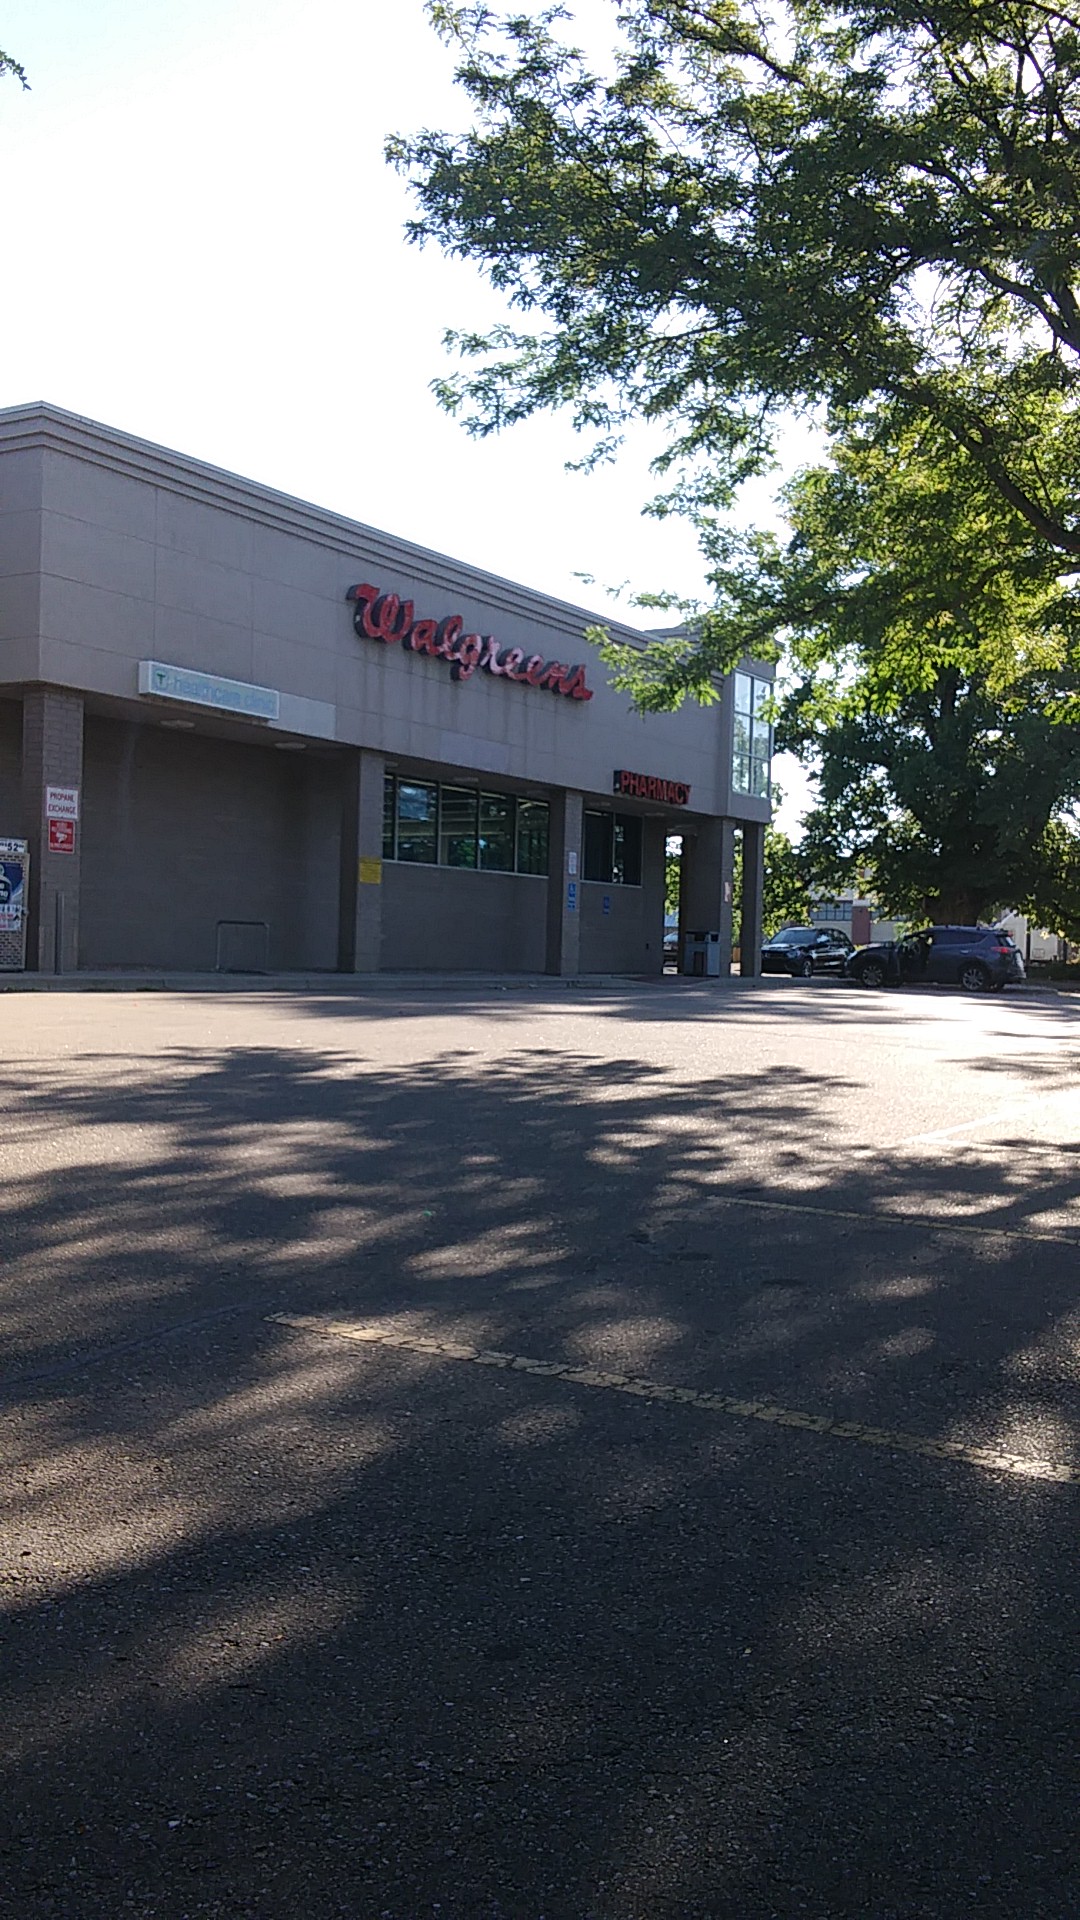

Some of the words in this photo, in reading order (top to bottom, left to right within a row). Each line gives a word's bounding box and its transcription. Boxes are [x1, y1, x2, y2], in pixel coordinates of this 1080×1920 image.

[349, 583, 593, 700] Walgreens
[50, 791, 75, 803] PROPANE
[619, 769, 692, 805] PHARMACY
[48, 803, 77, 815] EXCHANGE
